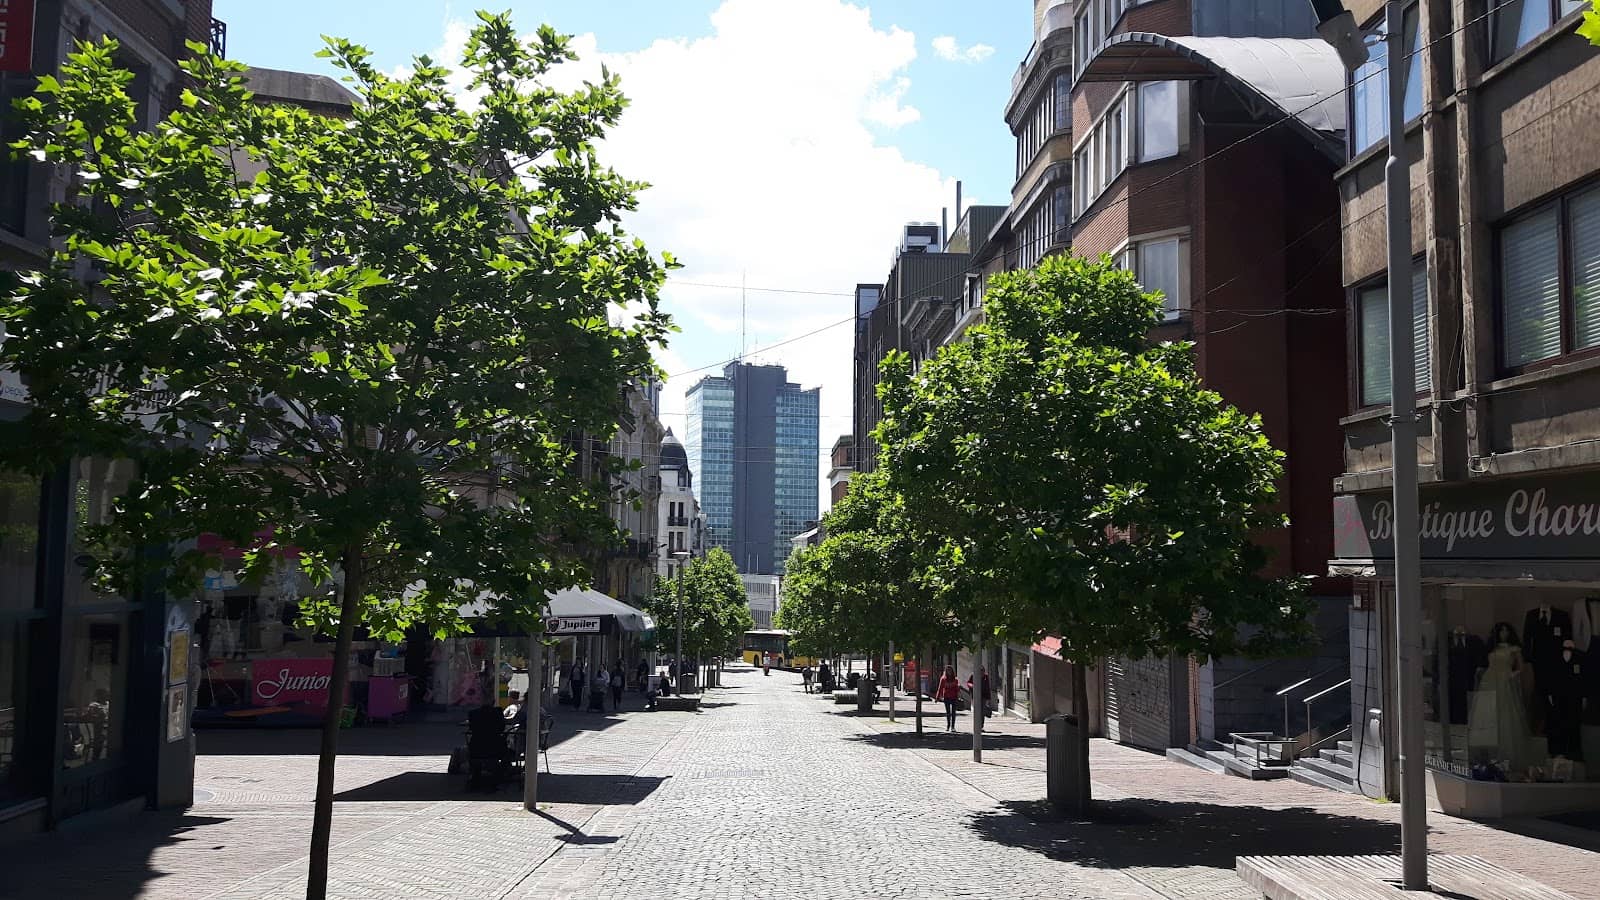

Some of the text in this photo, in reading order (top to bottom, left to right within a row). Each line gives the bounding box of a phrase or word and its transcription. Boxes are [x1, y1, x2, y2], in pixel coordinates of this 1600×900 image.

[1370, 487, 1600, 553] Btique Char
[560, 620, 598, 630] Jupiler
